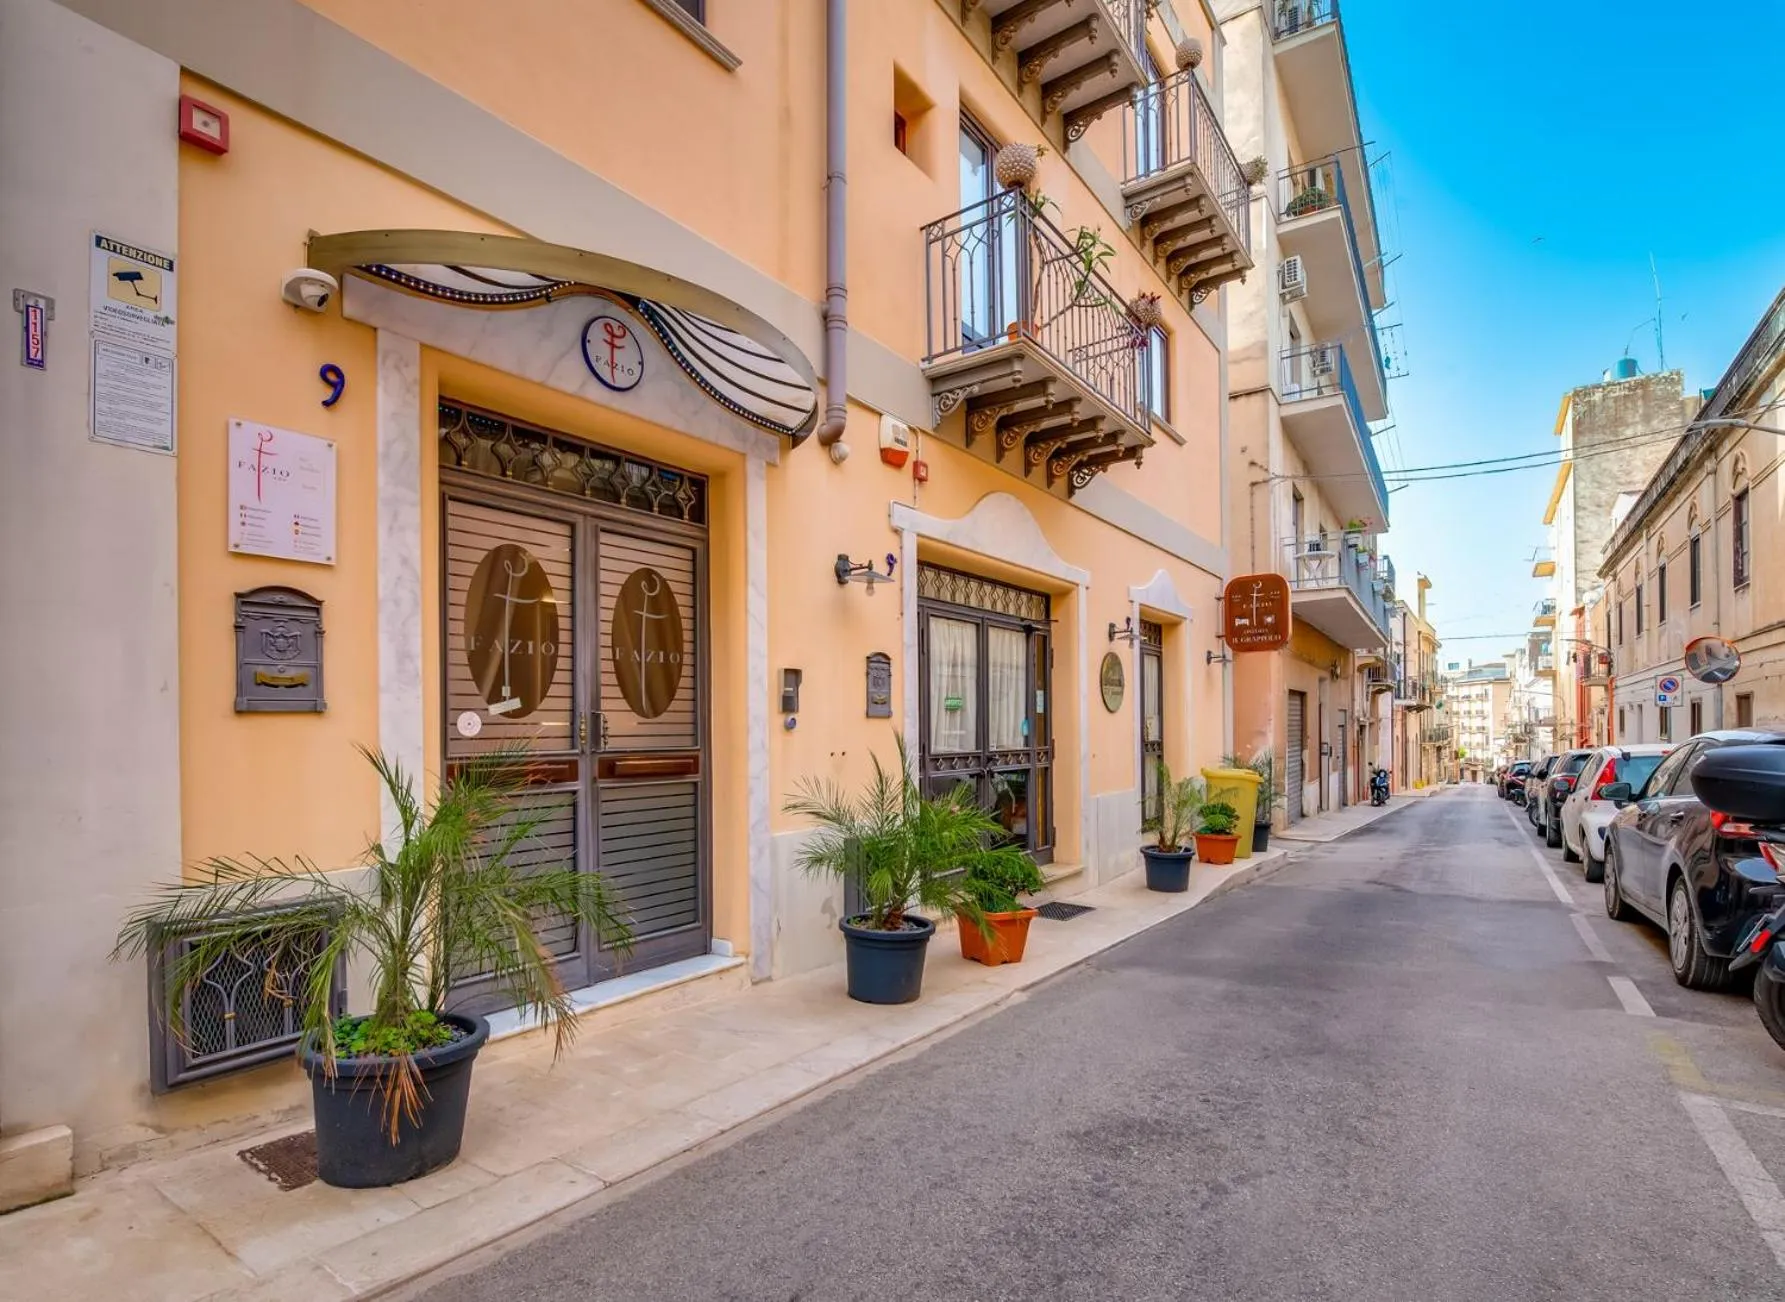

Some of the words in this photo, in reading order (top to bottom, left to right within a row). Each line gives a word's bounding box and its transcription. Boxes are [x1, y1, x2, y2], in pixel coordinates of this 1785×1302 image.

[100, 238, 170, 269] ATTENZIONE
[595, 355, 634, 376] FAZIO
[320, 363, 345, 408] 9
[238, 460, 291, 478] FAZIO
[470, 636, 556, 656] FAZIO
[616, 647, 681, 665] FAZIO
